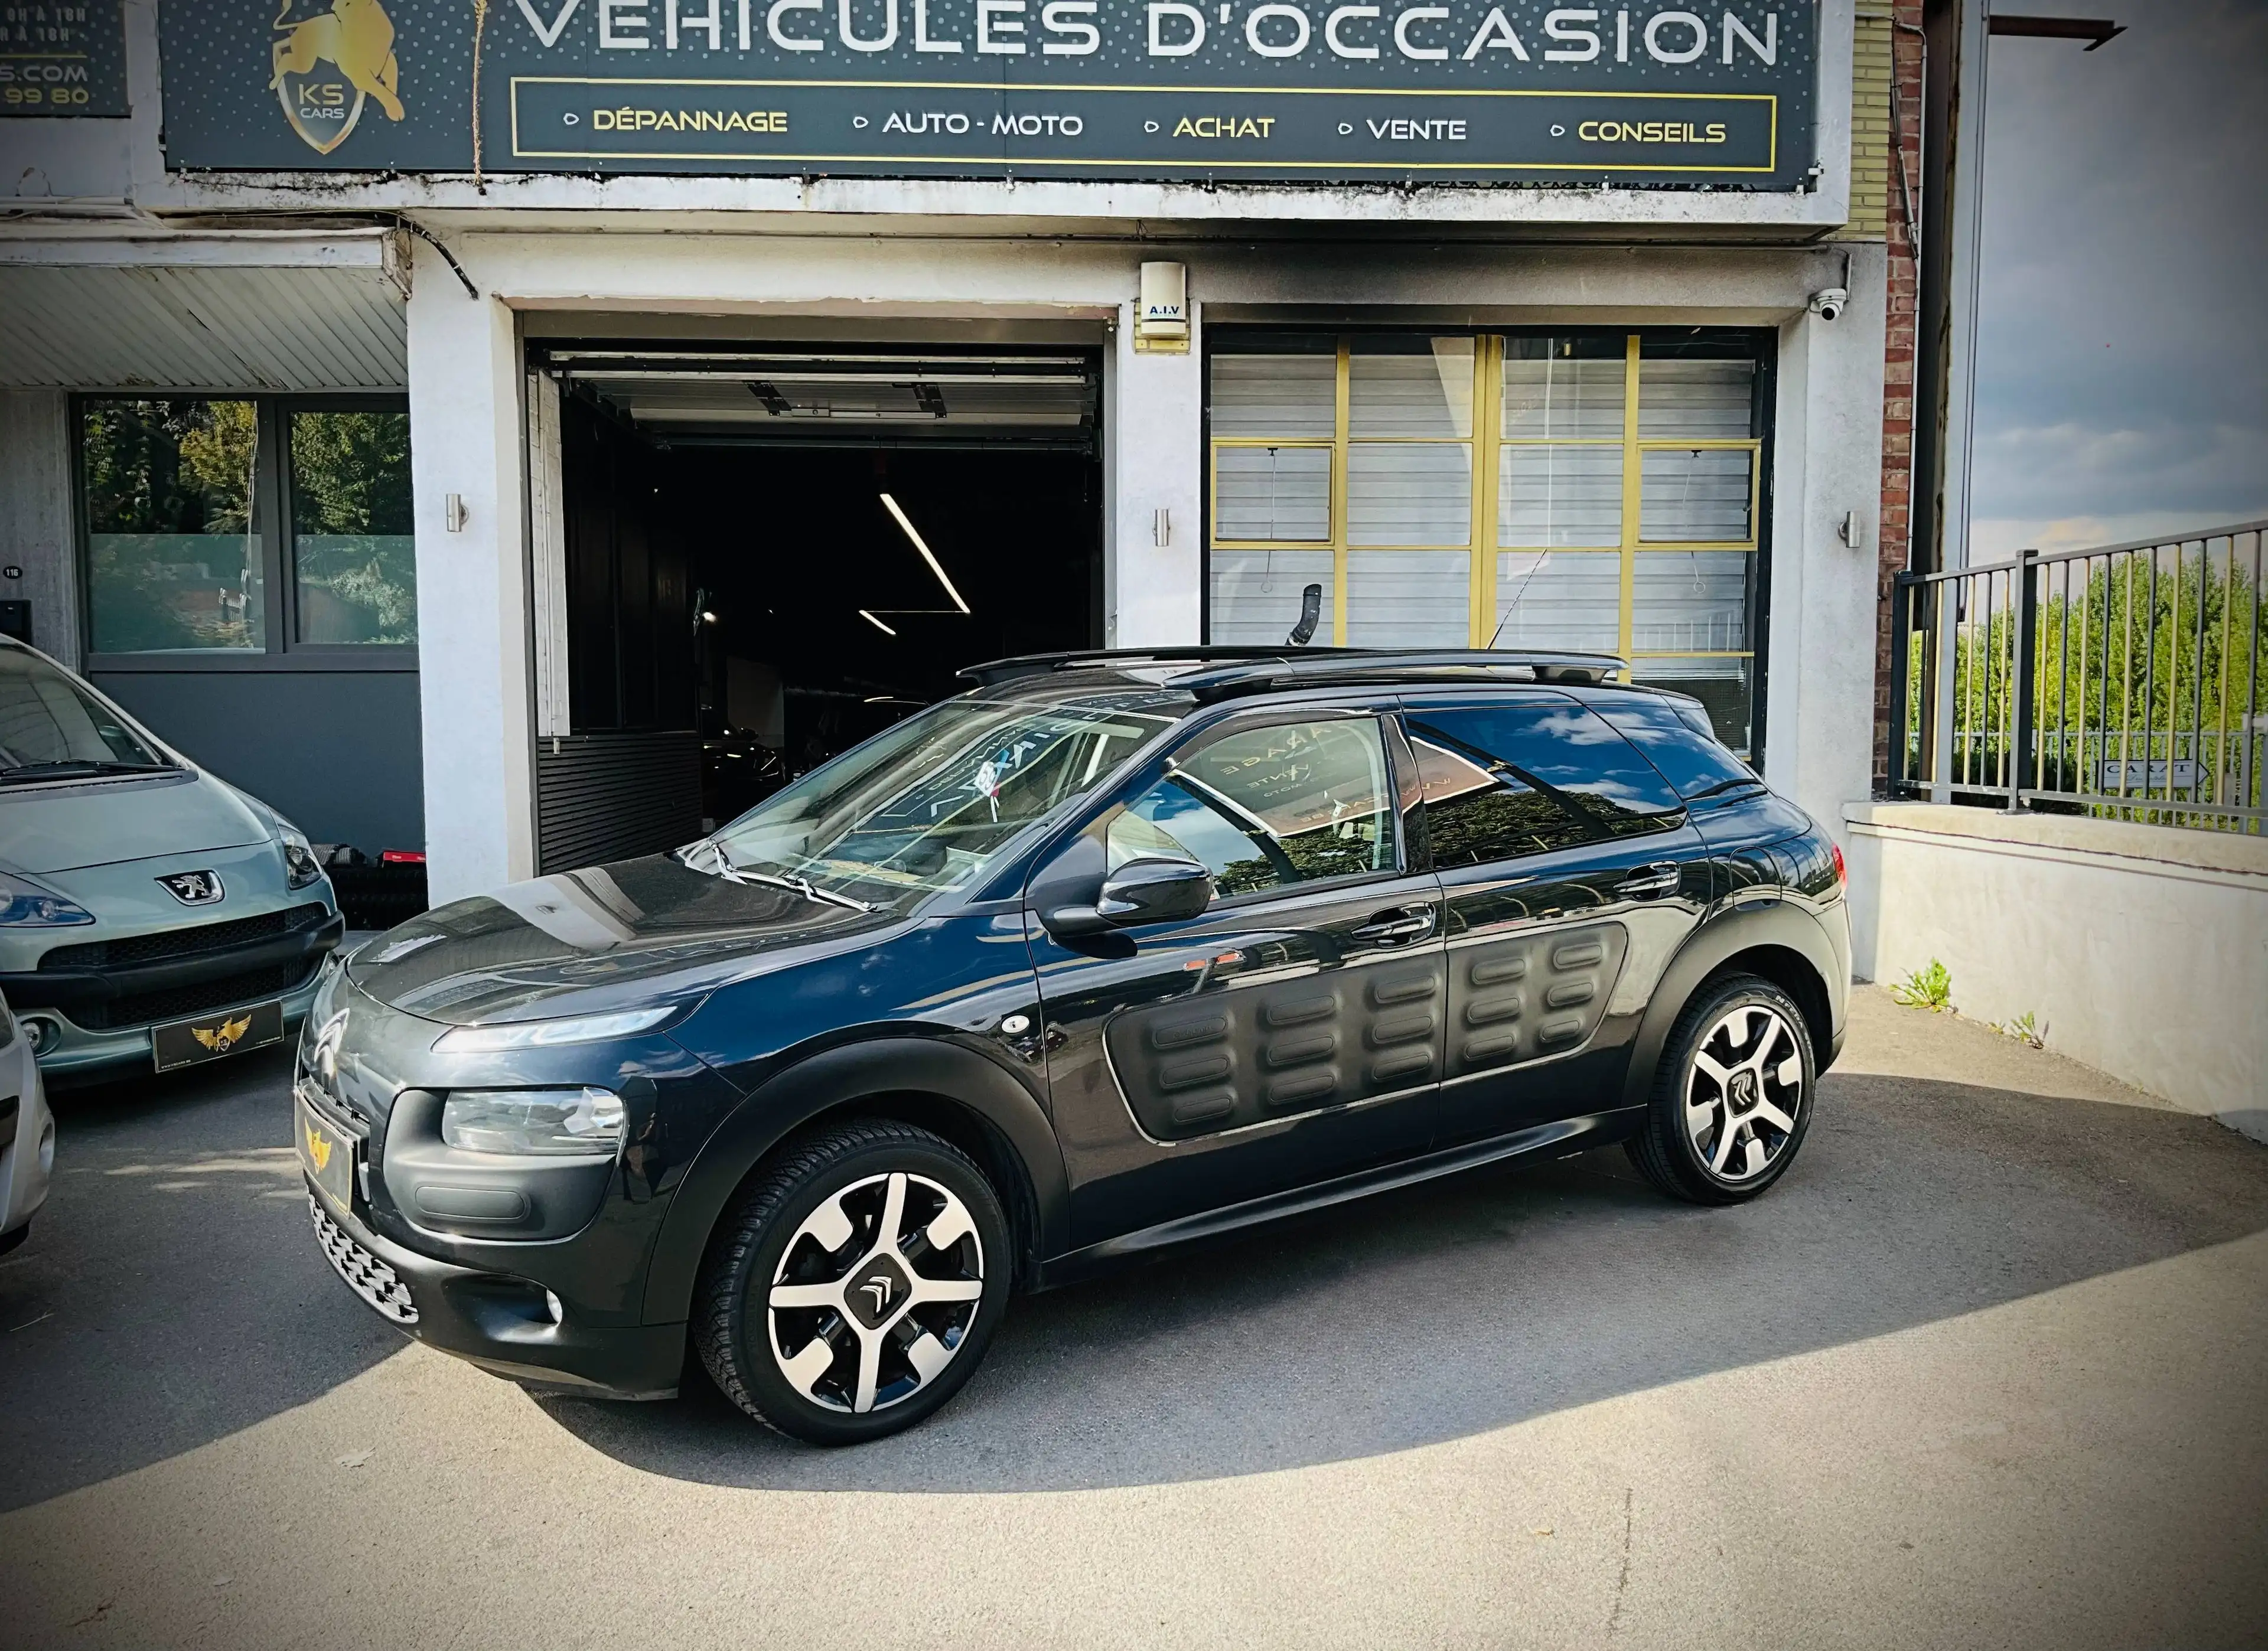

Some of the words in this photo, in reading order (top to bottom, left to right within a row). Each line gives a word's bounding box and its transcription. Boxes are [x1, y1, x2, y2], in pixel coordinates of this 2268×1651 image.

[1148, 3, 1777, 66] D'OCCASION
[5, 87, 43, 104] 99
[51, 87, 89, 104] 80
[298, 83, 344, 105] KS
[299, 107, 345, 119] CARS
[593, 106, 788, 133] DÉPANNAGE
[881, 112, 970, 134] AUTO
[991, 115, 1084, 136] MOTO
[1172, 118, 1276, 138] ACHAT
[1366, 119, 1467, 141] VENTE
[1578, 121, 1726, 143] CONSEILS
[1149, 305, 1180, 314] A.I.V
